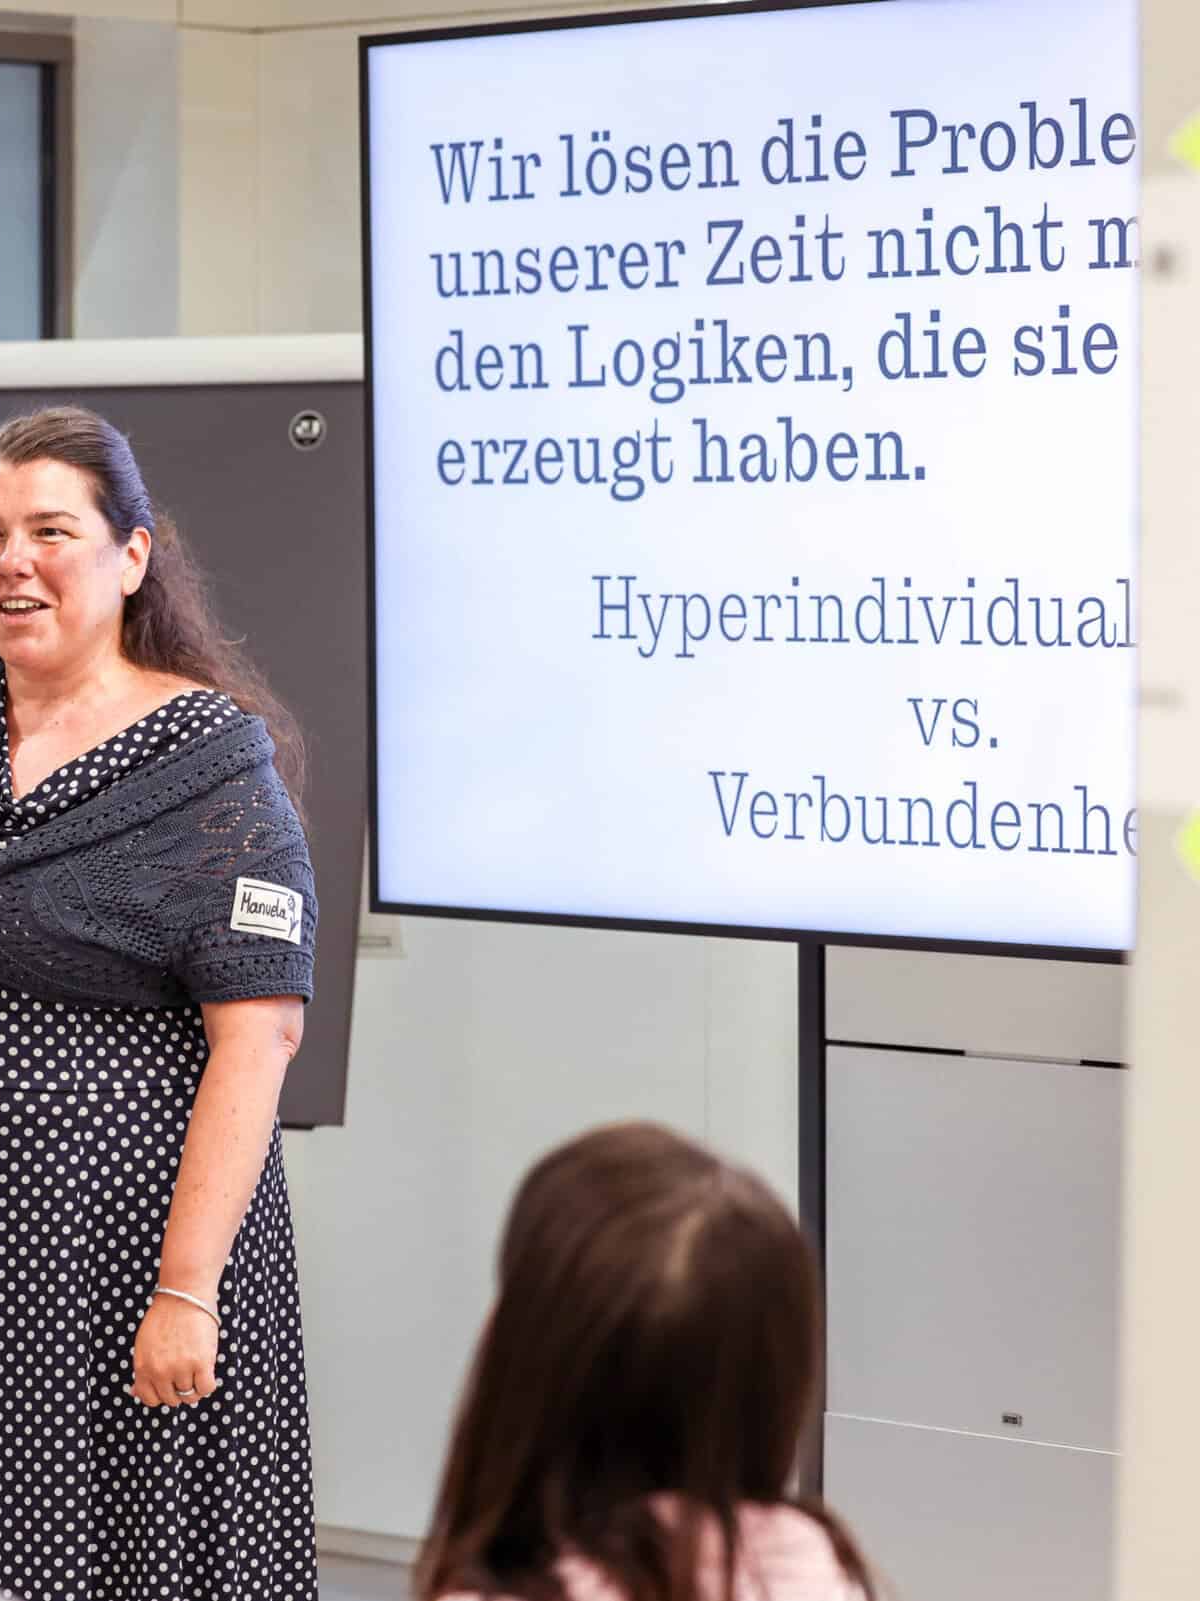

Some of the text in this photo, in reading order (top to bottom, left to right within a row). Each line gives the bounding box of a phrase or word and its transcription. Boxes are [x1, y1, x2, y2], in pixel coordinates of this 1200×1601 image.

[430, 98, 1137, 204] Wir lösen die Proble
[430, 240, 685, 297] unserer
[706, 214, 845, 285] Zeit
[868, 202, 1064, 278] nicht
[435, 305, 1118, 404] den Logiken, die sie
[437, 416, 925, 502] erzeugt haben.
[592, 576, 1137, 658] Hyperindividual
[907, 698, 997, 748] vs.
[240, 891, 287, 920] Manuela
